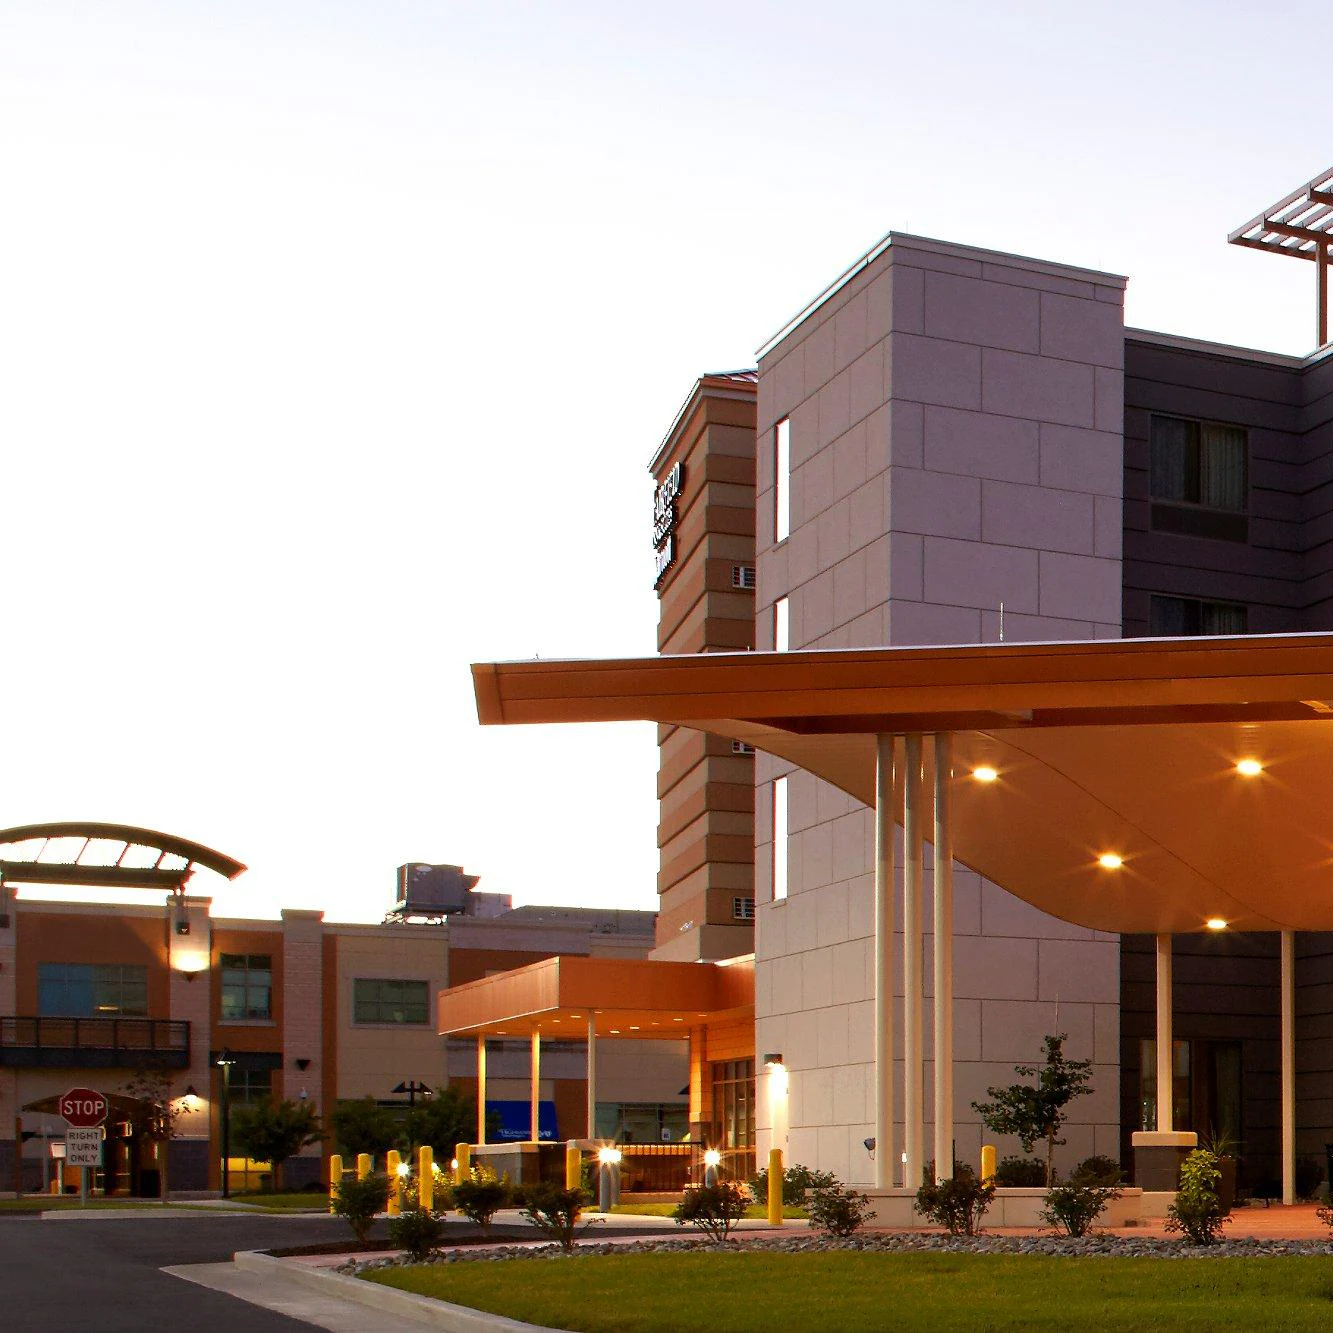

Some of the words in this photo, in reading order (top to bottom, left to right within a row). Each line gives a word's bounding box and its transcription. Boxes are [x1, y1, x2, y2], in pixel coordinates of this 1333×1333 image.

[64, 1100, 105, 1115] STOP
[68, 1132, 99, 1140] RIGHT
[71, 1143, 98, 1151] TURN
[70, 1154, 98, 1162] ONLY
